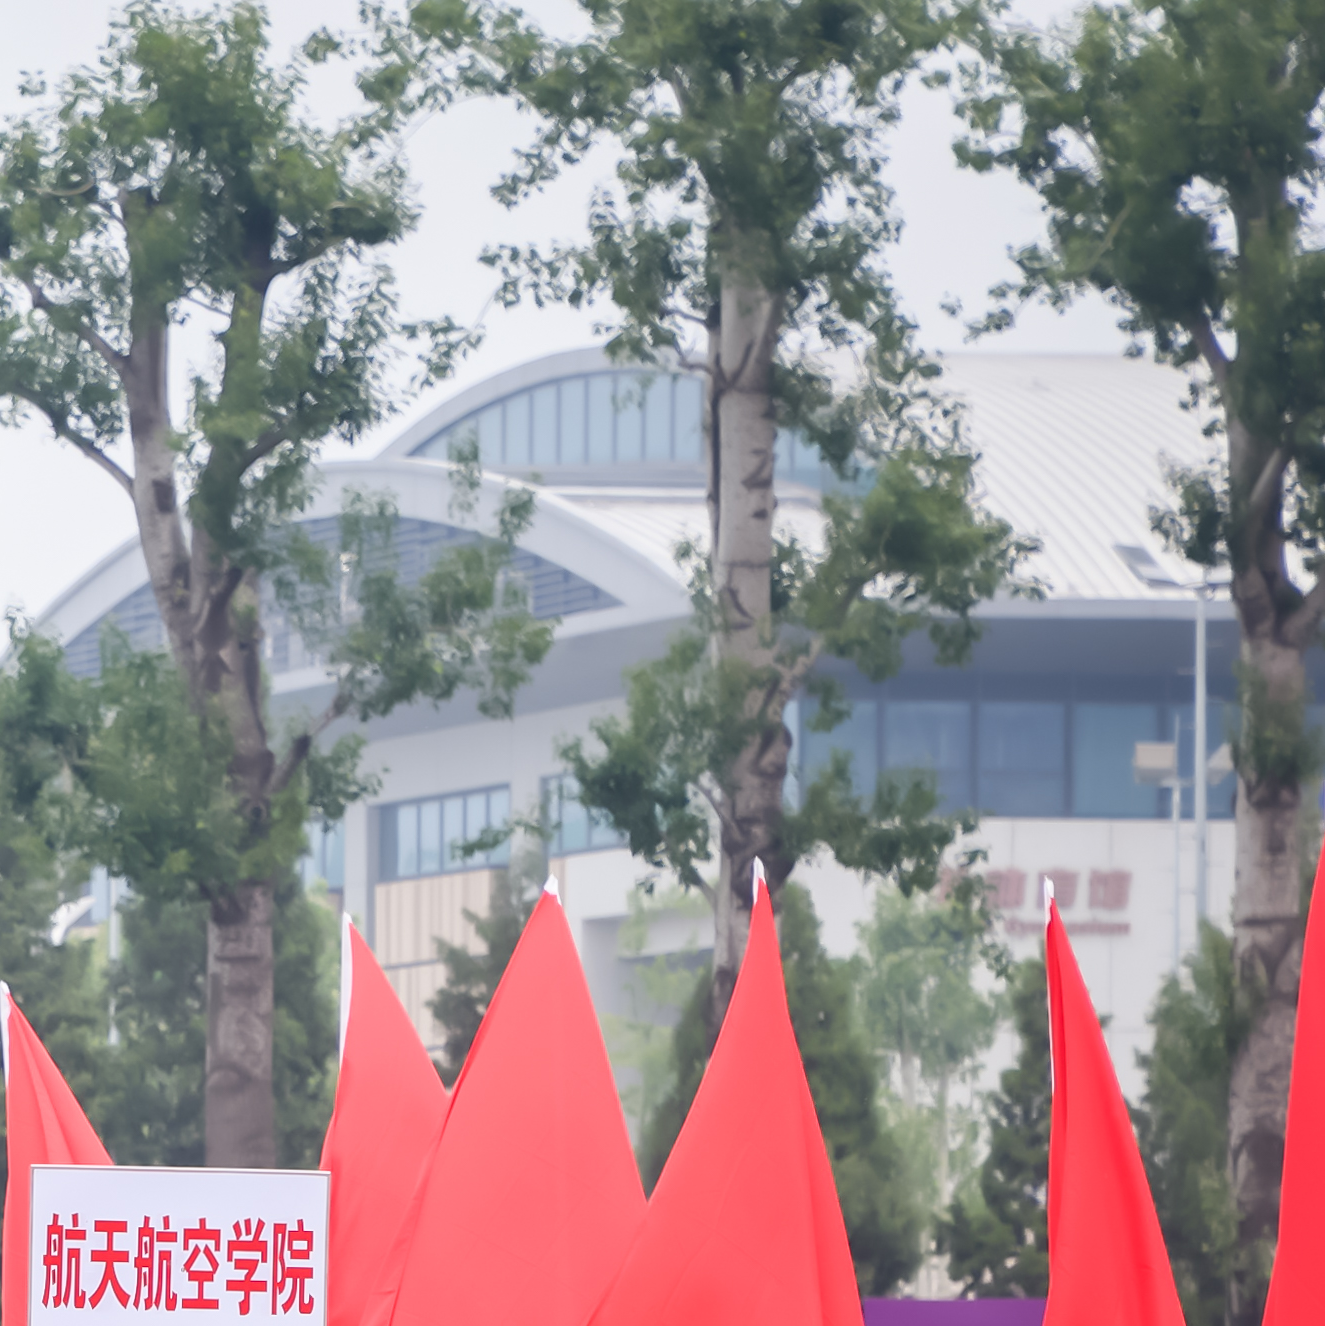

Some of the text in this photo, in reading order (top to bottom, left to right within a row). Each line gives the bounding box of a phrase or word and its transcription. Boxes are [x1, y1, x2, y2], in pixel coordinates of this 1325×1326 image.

[42, 1213, 315, 1316] 航天航空学院
